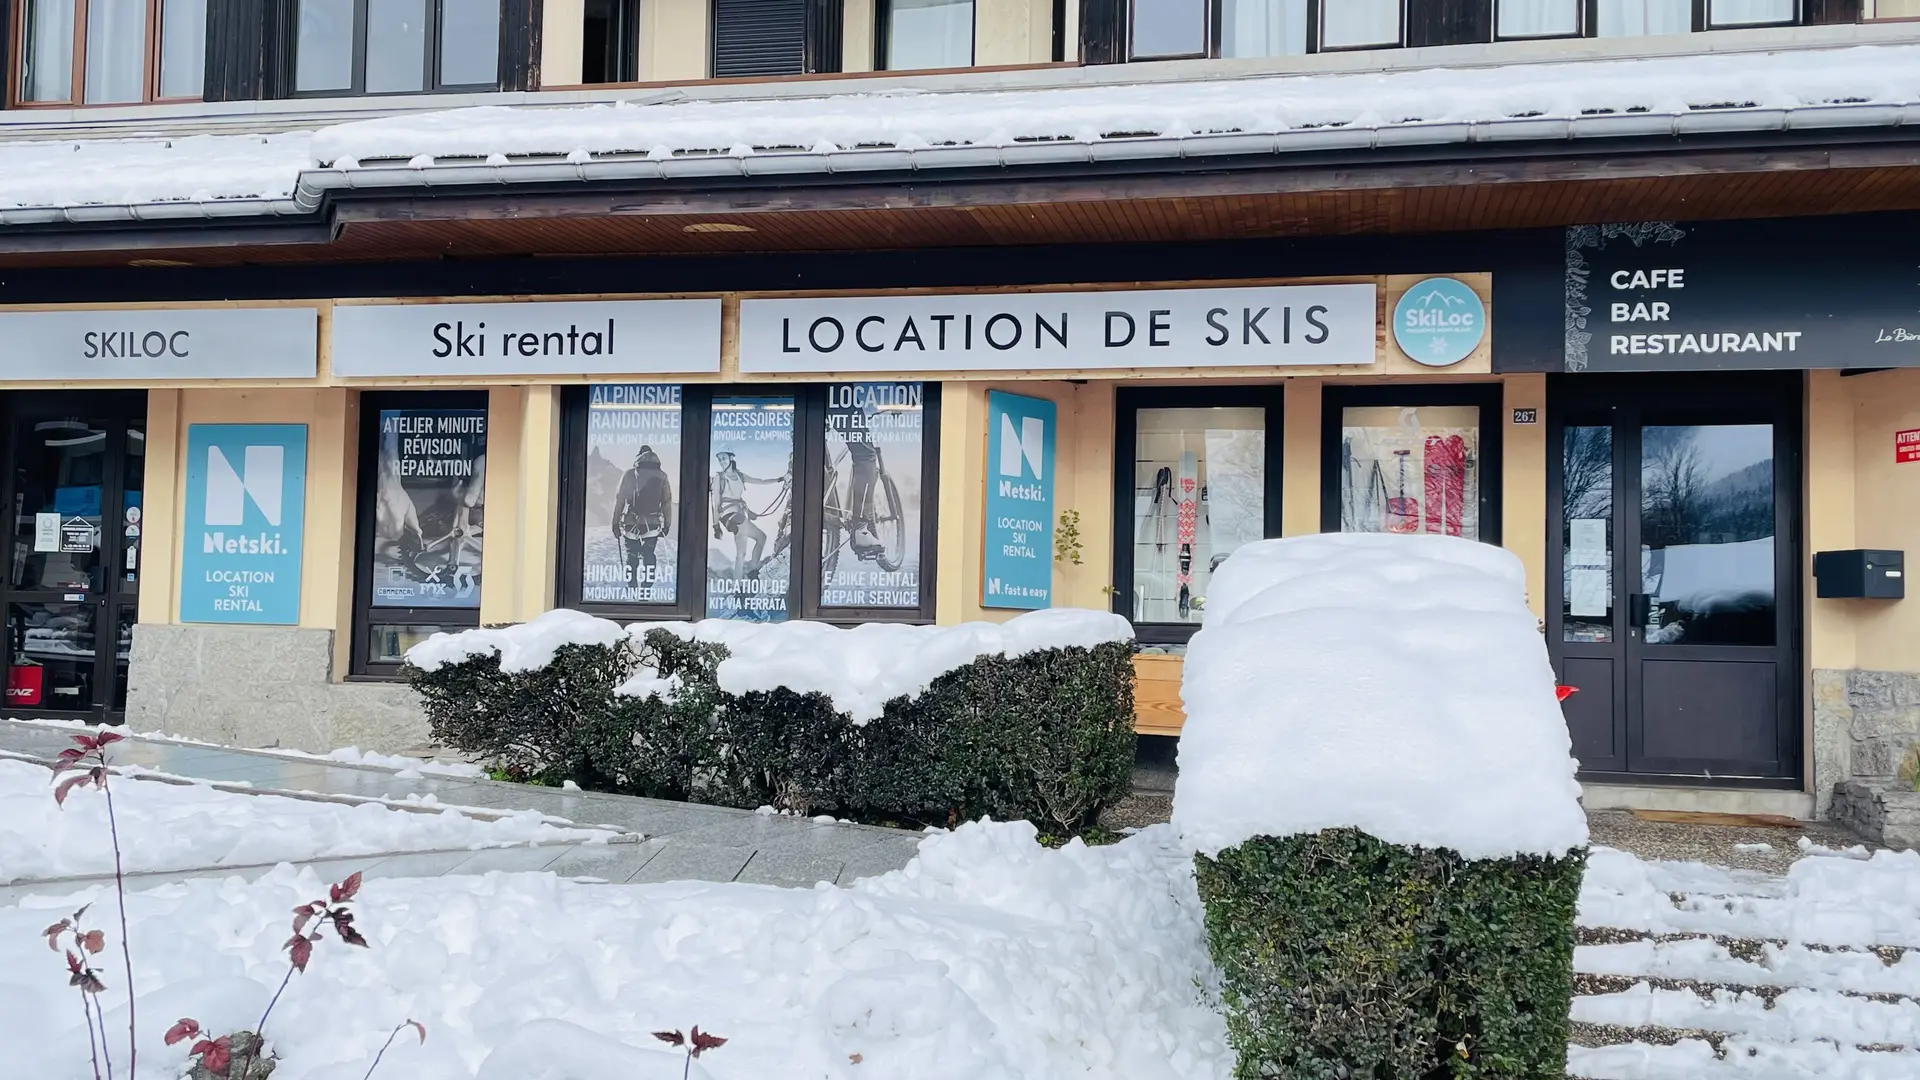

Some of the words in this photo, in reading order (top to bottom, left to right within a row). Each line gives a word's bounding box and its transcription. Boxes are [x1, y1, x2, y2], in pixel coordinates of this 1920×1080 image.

[1610, 269, 1685, 290] CAFE
[1405, 308, 1474, 327] SkiLoc
[1611, 302, 1671, 322] BAR
[782, 312, 1068, 353] LOCATION
[1105, 310, 1171, 347] DE
[1205, 305, 1329, 346] SKIS
[83, 331, 189, 358] SKILOC
[432, 321, 486, 357] Ski
[503, 318, 615, 356] rental
[1611, 331, 1801, 355] RESTAURANT
[592, 386, 681, 405] ALPINISME
[829, 385, 921, 408] LOCATION
[714, 412, 791, 427] ACCESSOIRES
[828, 414, 848, 429] VTT
[851, 411, 920, 429] ÉLECTRIQUE
[1515, 411, 1535, 422] 267
[383, 417, 433, 433] ATELIER
[438, 417, 484, 433] MINUTE
[590, 433, 615, 446] PACK
[714, 430, 746, 441] BIVOUAC
[755, 430, 790, 441] CAMPING
[828, 432, 862, 443] ATELIER
[404, 434, 461, 455] RÉVISION
[392, 455, 472, 476] RÉPARATION
[1000, 480, 1045, 502] Netski.
[998, 517, 1042, 532] LOCATION
[203, 532, 288, 555] Netski.
[1012, 532, 1027, 544] SKI
[1003, 545, 1036, 559] RENTAL
[206, 570, 275, 584] LOCATION
[587, 564, 632, 583] HIKING
[636, 565, 673, 583] GEAR
[824, 571, 866, 586] E-BIKE
[870, 572, 918, 587] RENTAL
[229, 585, 249, 597] SKI
[420, 583, 446, 595] FOX
[585, 586, 674, 601] MOUNTAINEERING
[710, 578, 766, 595] LOCATION
[771, 579, 787, 595] DE
[1004, 584, 1020, 596] fast
[1029, 589, 1048, 601] easy
[214, 599, 263, 612] RENTAL
[709, 597, 723, 611] KIT
[726, 597, 742, 611] VIA
[744, 597, 787, 611] FERRATA
[824, 590, 865, 604] REPAIR
[869, 590, 917, 605] SERVICE
